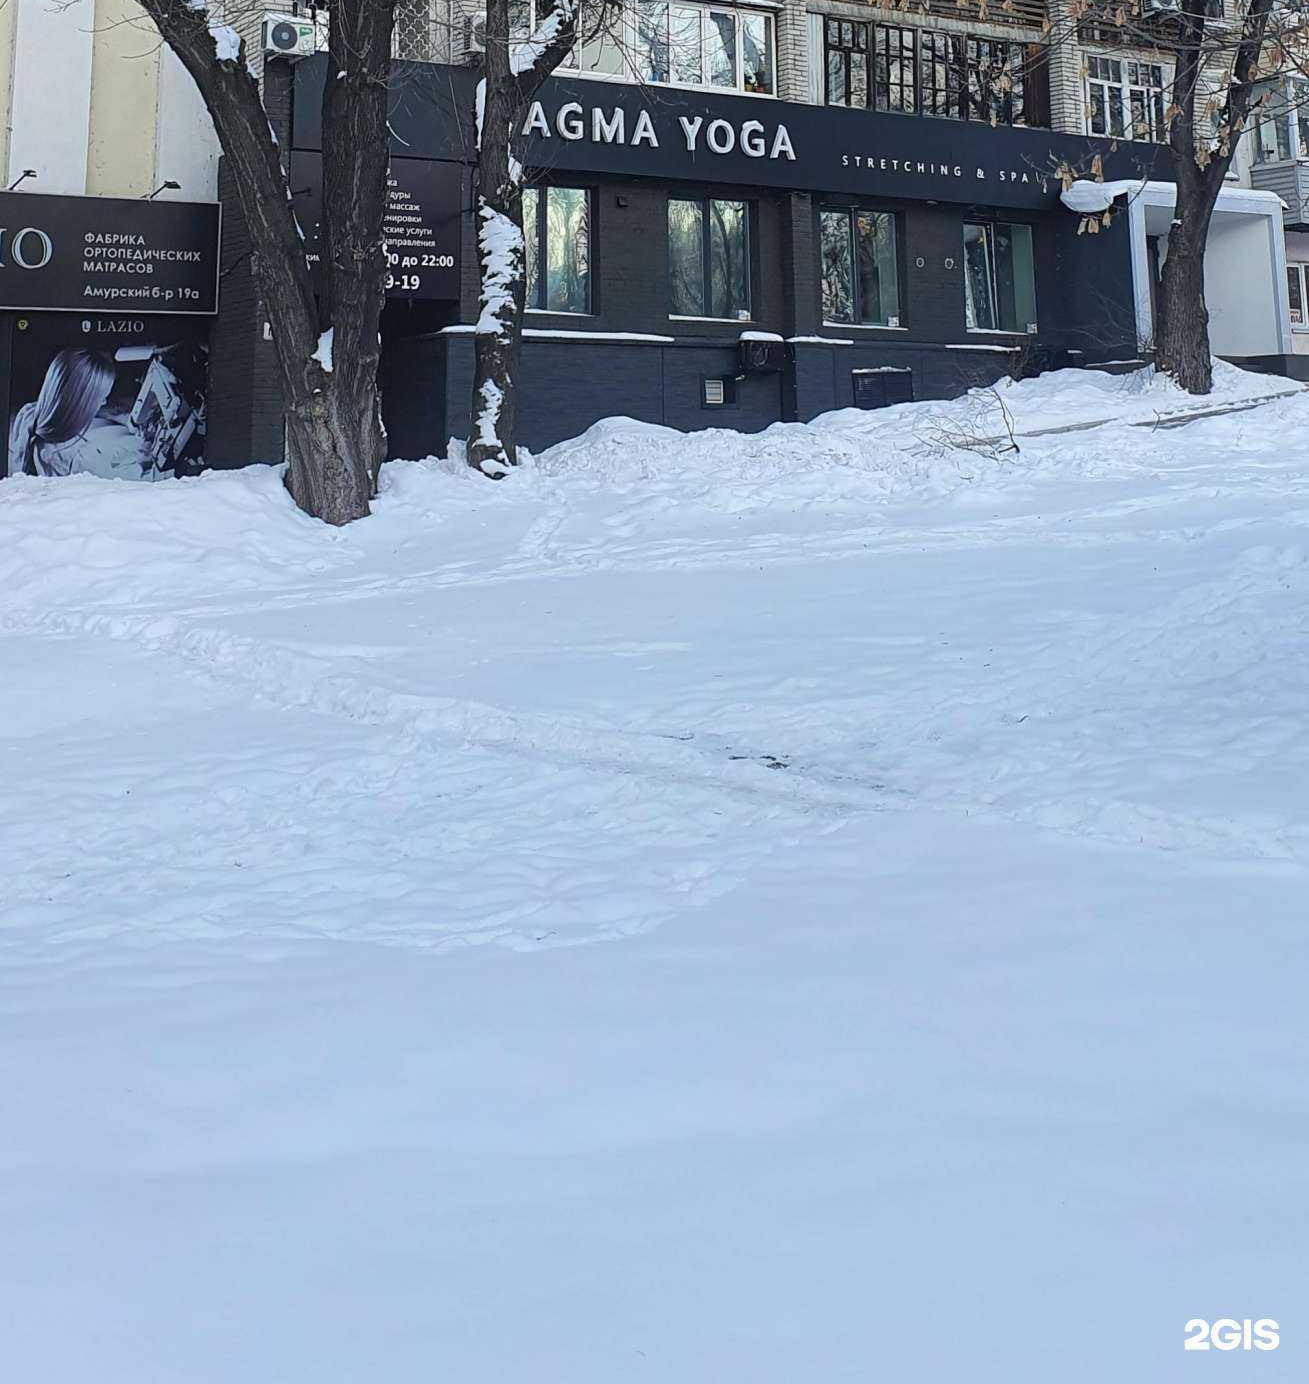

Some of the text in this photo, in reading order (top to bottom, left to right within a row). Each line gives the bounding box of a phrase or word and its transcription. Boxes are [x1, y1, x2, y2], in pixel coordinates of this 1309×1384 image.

[521, 101, 797, 161] AGMA YOGA
[842, 155, 1029, 183] STRETCHING & SPA
[390, 191, 411, 200] дуры
[390, 203, 420, 212] массаж
[384, 215, 422, 224] нировки
[84, 232, 146, 245] ФАБРИКА
[406, 227, 433, 237] услуги
[83, 247, 201, 262] ОРТОПЕДИЧЕСКИХ
[401, 256, 418, 268] до
[421, 254, 454, 268] 22:00
[83, 262, 153, 274] МАТРАСОВ
[385, 274, 420, 290] 9-19
[83, 285, 199, 301] Амурский б-р 19а
[97, 320, 144, 333] LAZIO
